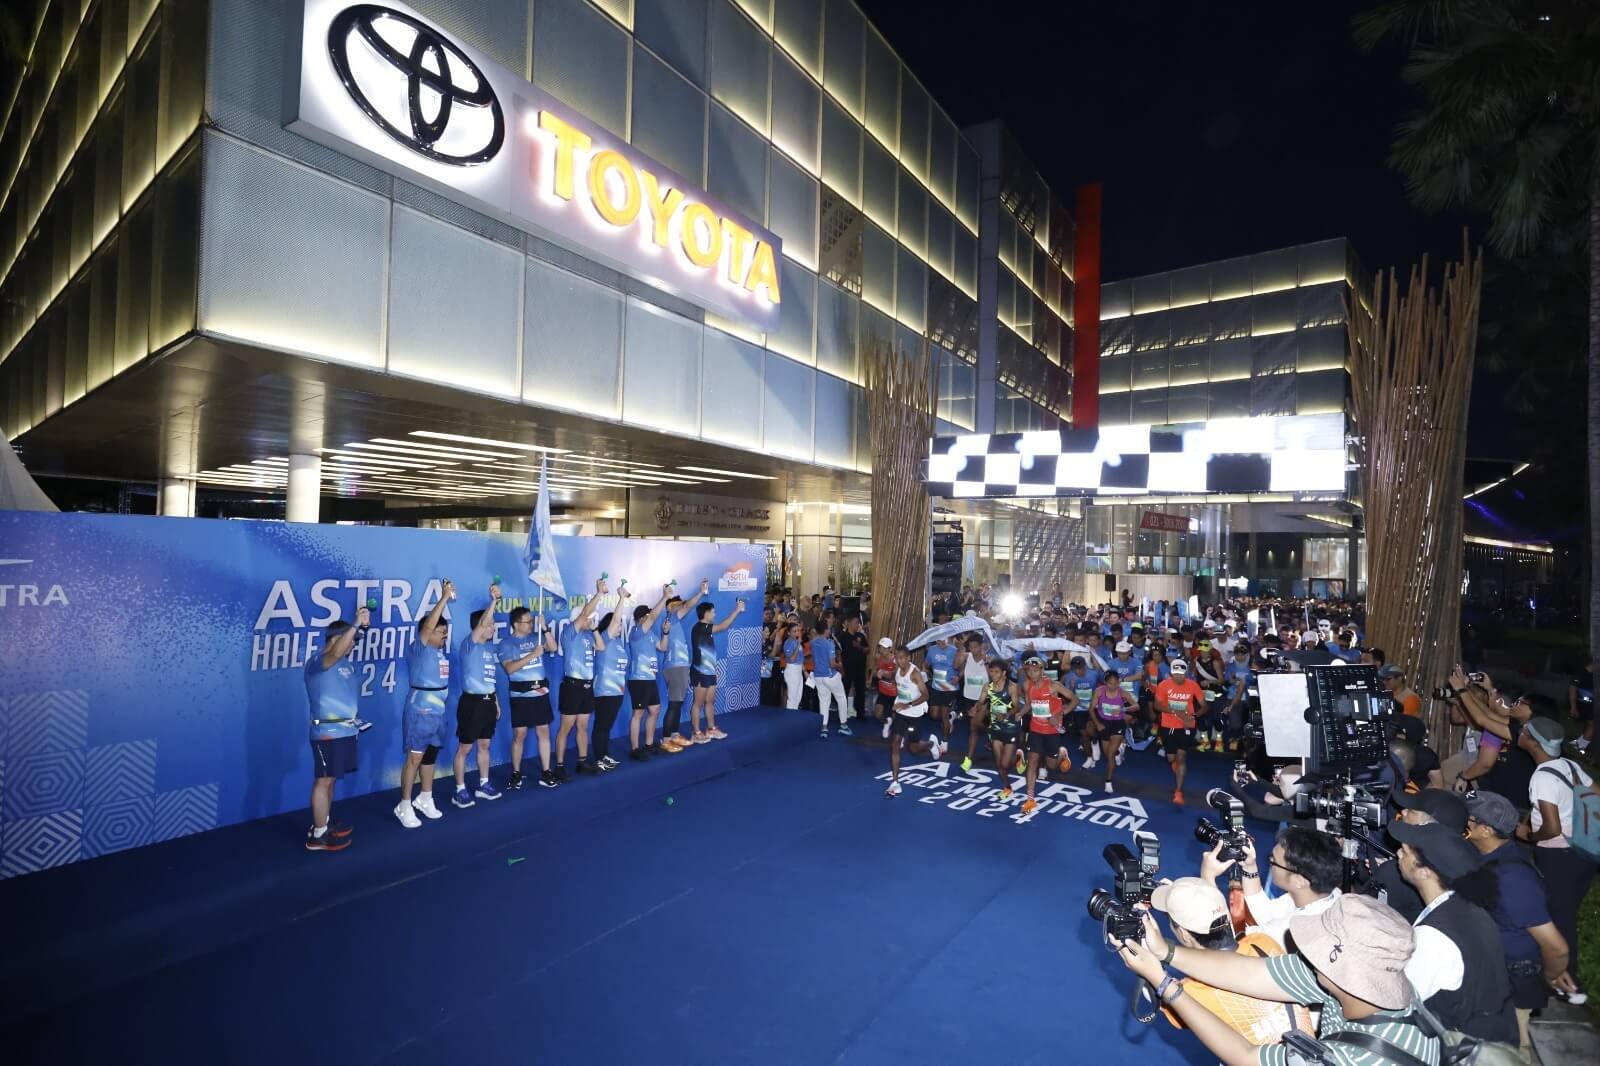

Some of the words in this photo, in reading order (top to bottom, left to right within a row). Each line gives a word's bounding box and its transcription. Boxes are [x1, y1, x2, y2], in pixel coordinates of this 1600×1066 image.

[537, 110, 781, 304] TOYOTA
[254, 578, 452, 630] ASTRA
[250, 631, 321, 672] HALF
[873, 770, 959, 789] HALF
[899, 760, 1150, 819] ASTRA
[917, 791, 1042, 824] 2024
